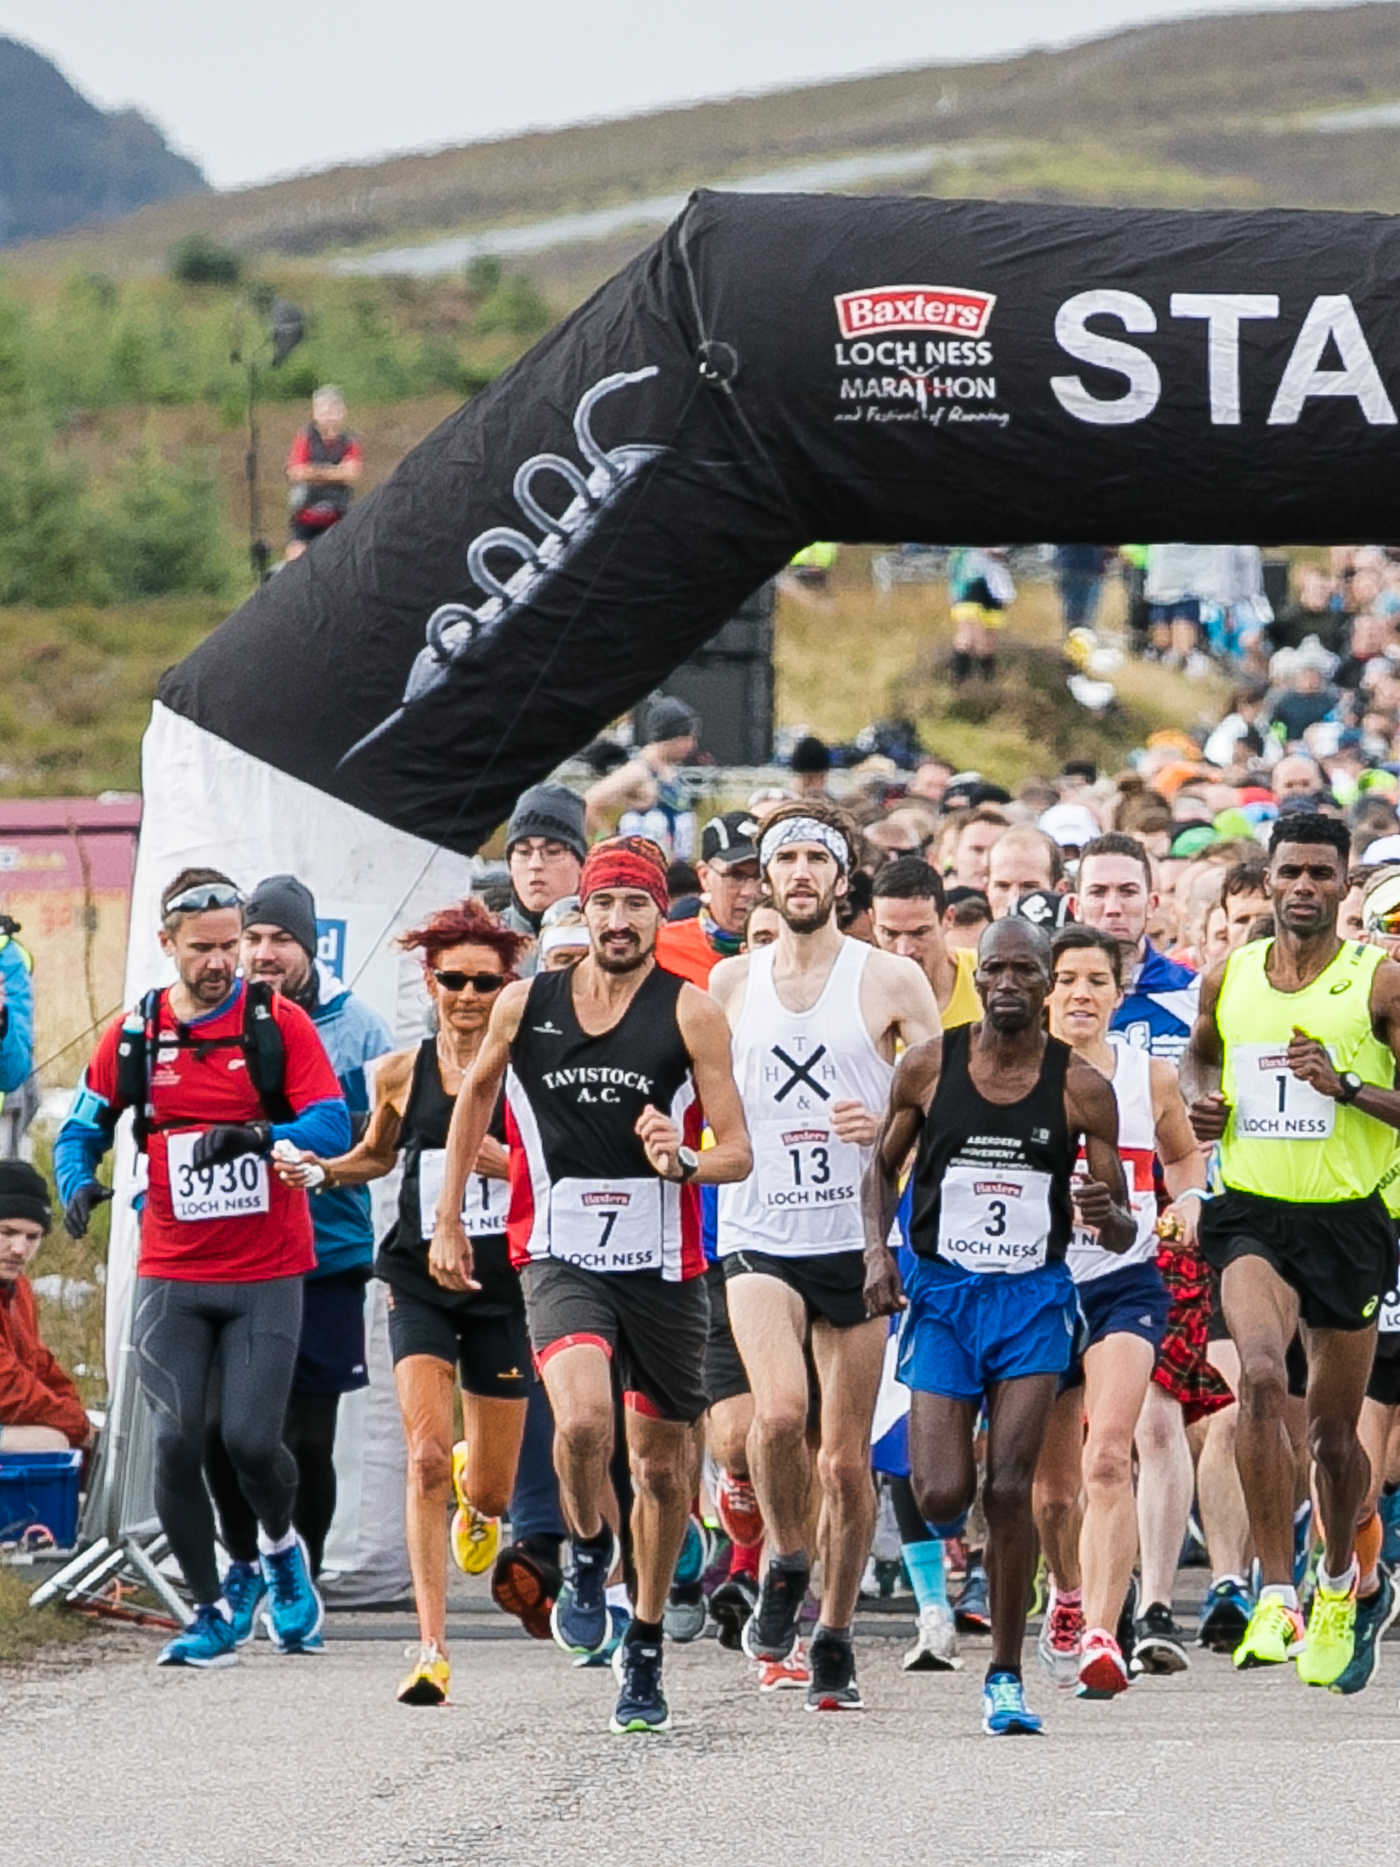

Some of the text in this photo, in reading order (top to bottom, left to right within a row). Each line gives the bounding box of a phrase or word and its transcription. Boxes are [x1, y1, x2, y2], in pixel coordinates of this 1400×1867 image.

[848, 294, 981, 328] Baxters
[835, 341, 993, 366] LOCH NESS
[541, 1066, 655, 1096] TAVISTOCK
[1276, 1075, 1287, 1113] 1
[1242, 1118, 1327, 1133] LOCH NESS
[178, 1158, 259, 1198] 3930
[788, 1147, 831, 1186] 13
[181, 1195, 261, 1216] LOCH NESS
[767, 1186, 855, 1206] LOCH NESS
[480, 1215, 509, 1230] NES
[598, 1210, 619, 1248] 7
[984, 1200, 1007, 1237] 3
[612, 1249, 653, 1266] NESS
[946, 1238, 1039, 1258] LOCH NESS
